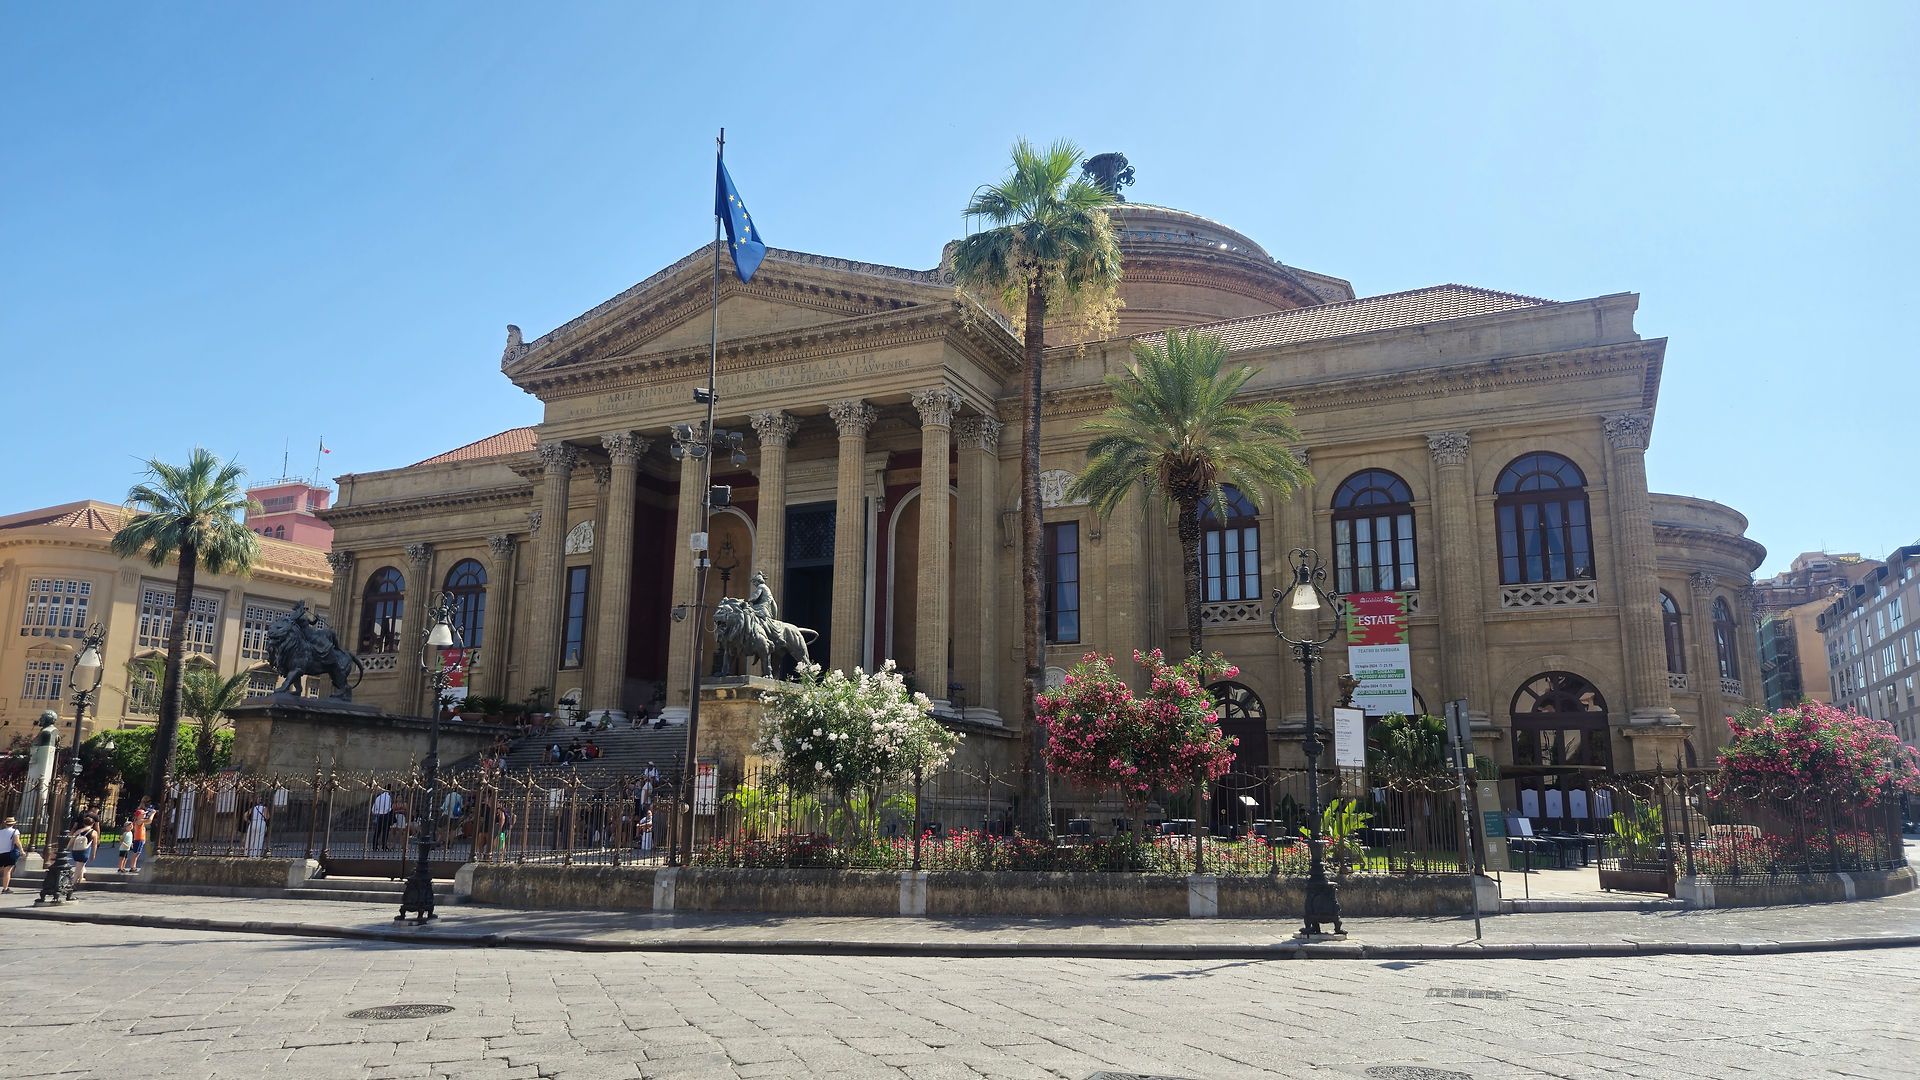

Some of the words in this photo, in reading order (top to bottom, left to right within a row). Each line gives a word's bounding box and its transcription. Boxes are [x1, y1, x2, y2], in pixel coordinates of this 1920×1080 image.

[638, 383, 687, 399] RINNOVA
[779, 364, 821, 378] RIVELA
[828, 359, 841, 370] LA
[848, 354, 876, 366] VITA
[1358, 614, 1396, 626] ESTATE
